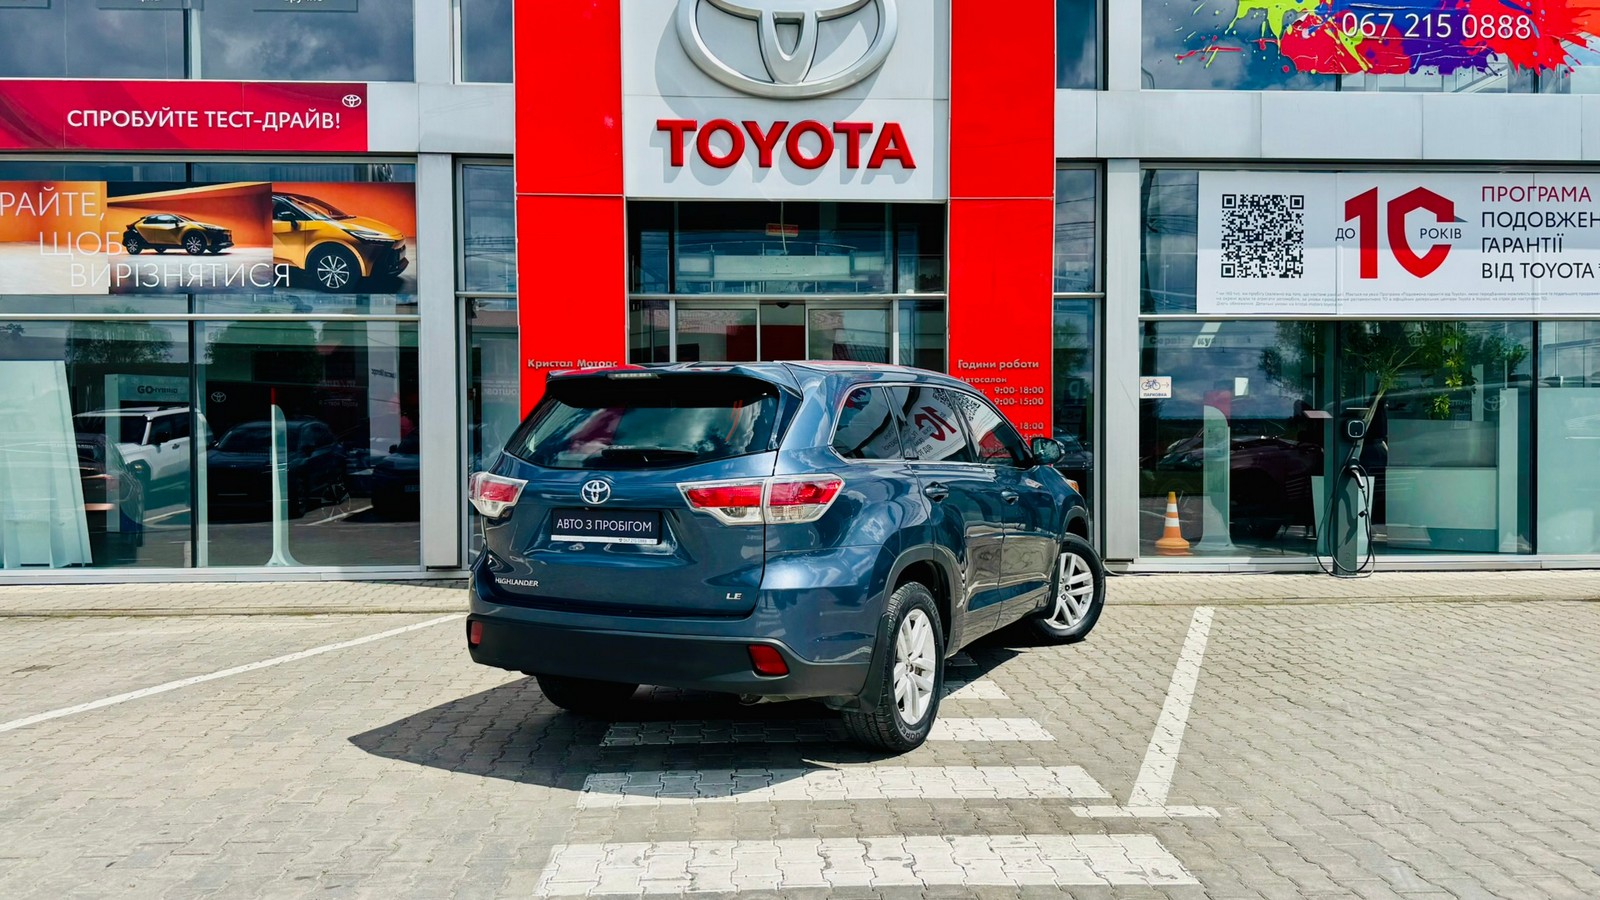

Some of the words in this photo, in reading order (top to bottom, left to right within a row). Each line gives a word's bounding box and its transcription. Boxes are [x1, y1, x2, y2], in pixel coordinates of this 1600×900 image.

[1342, 12, 1394, 38] 067
[1404, 13, 1451, 38] 215
[1462, 14, 1531, 39] 0888
[67, 107, 198, 128] СПРОБУЙТЕ
[204, 108, 341, 132] ТЕСТ-ДРАЙВ!
[656, 118, 917, 170] TOYOTA
[0, 186, 105, 221] РАЙТЕ,
[1481, 186, 1592, 203] ПРОГРАМА
[1335, 227, 1356, 241] ДО
[1344, 186, 1454, 279] 10
[1420, 227, 1462, 240] РОКІВ
[39, 230, 124, 261] ЩОБ
[1481, 233, 1564, 254] ГАРАНТІЇ
[70, 262, 291, 288] ВИРІЗНЯТИСЯ
[1481, 262, 1515, 282] ВІД
[1520, 262, 1595, 279] TOYOTA
[527, 358, 573, 369] Кристал
[577, 358, 618, 368] Моторс
[957, 359, 997, 369] Години
[999, 358, 1039, 370] роботи
[556, 518, 583, 530] АВТО
[594, 520, 652, 532] ПРОБІГОМ
[494, 577, 539, 587] HIGHLANDER
[725, 592, 742, 600] LE
